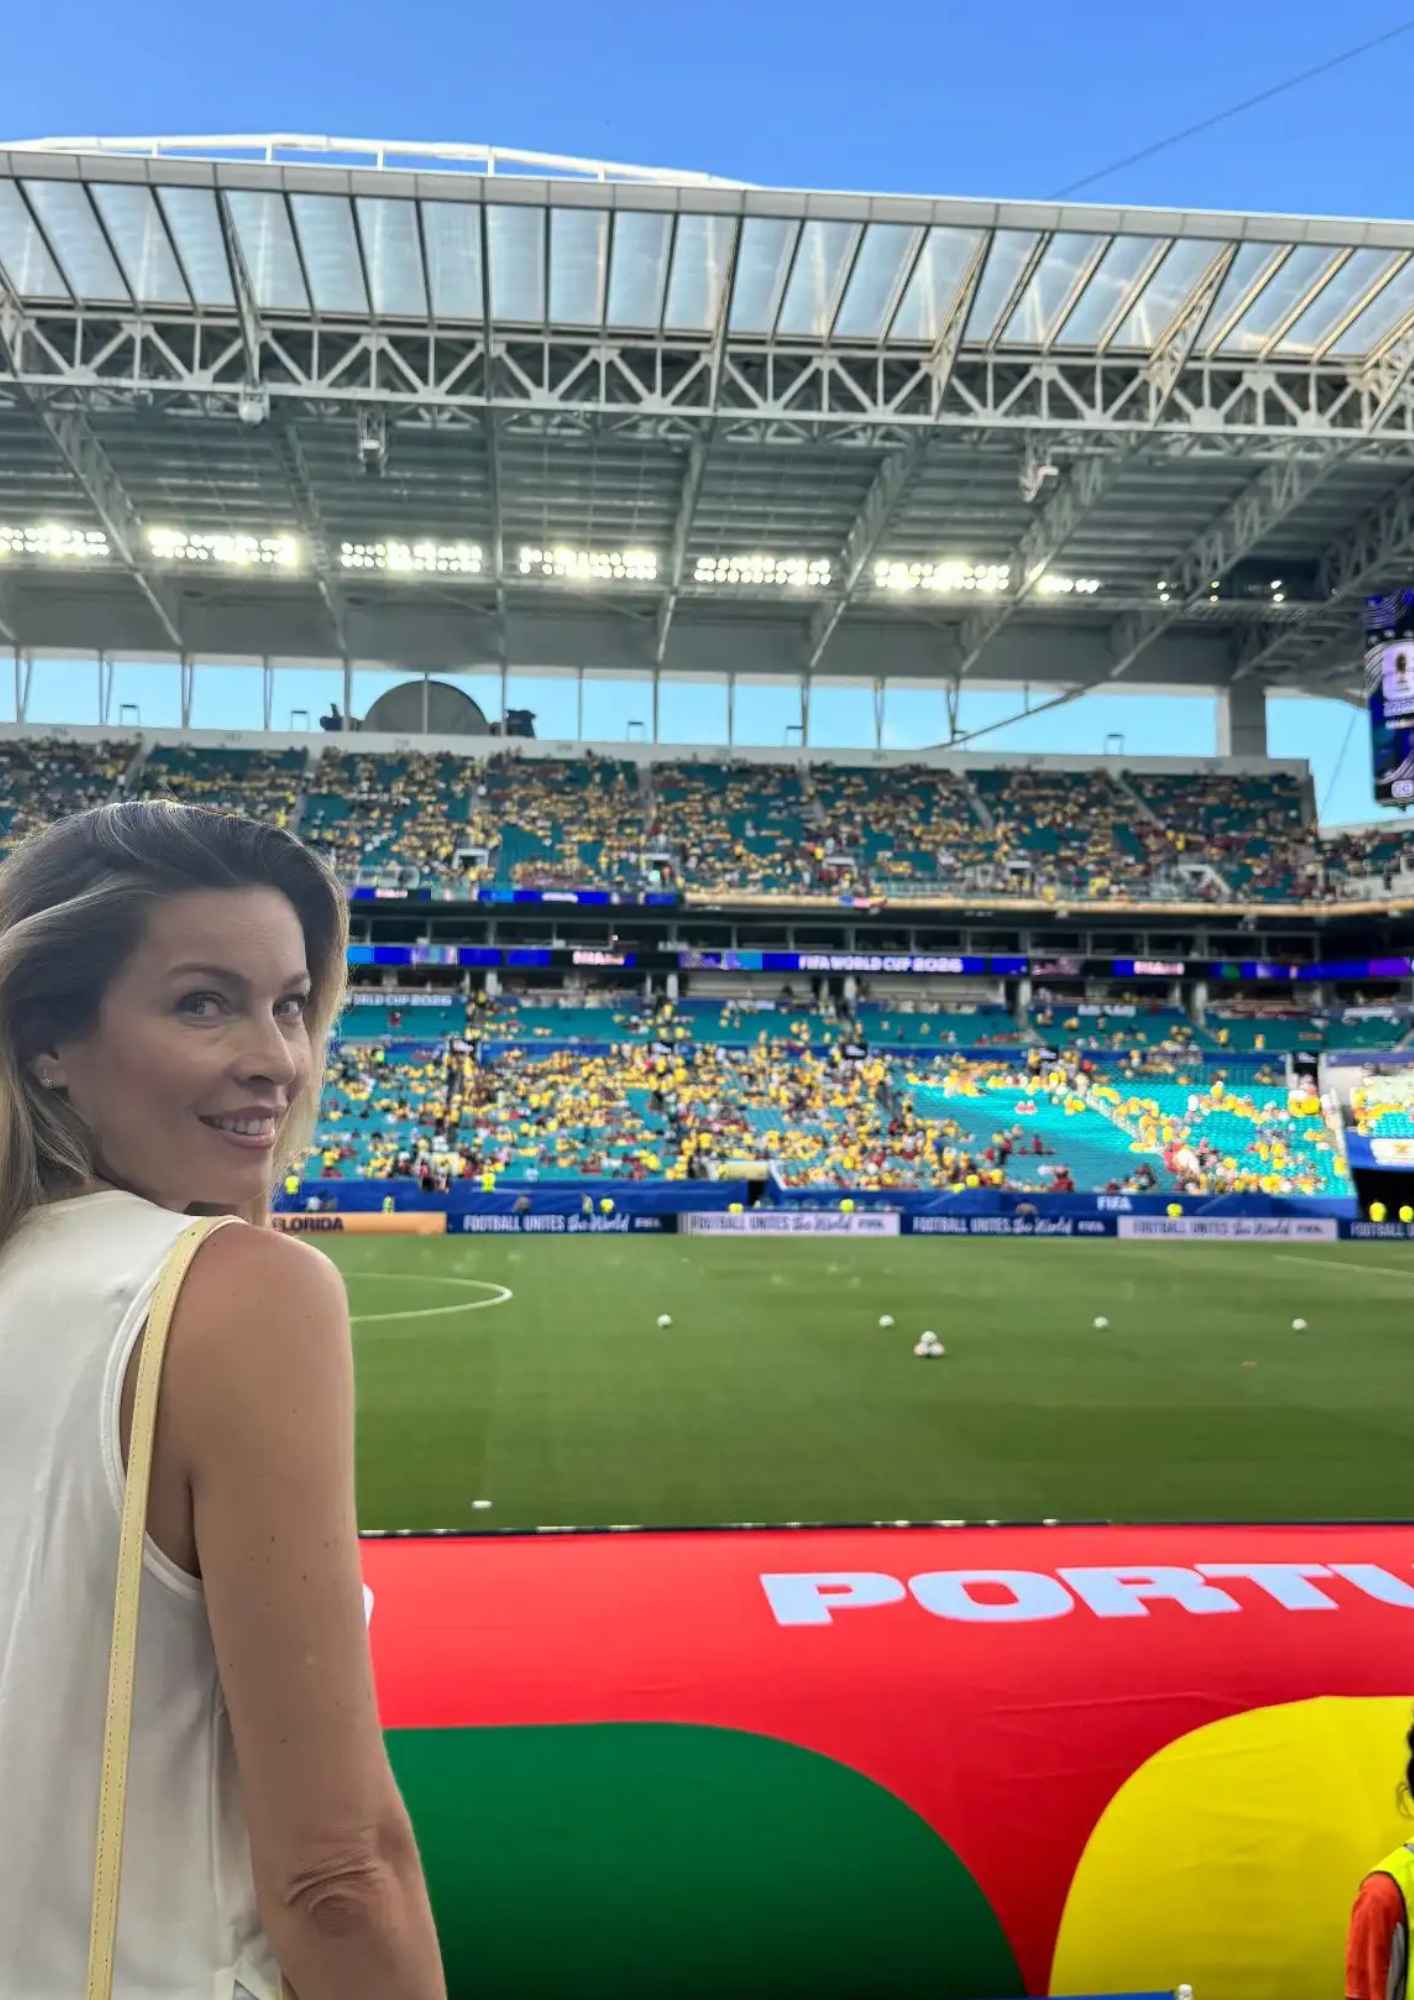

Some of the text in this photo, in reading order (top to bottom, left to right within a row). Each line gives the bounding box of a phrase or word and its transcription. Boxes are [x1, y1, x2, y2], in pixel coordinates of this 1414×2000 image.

[831, 955, 882, 972] WORLD
[883, 956, 912, 972] CUP
[912, 957, 964, 973] 2026
[1096, 1196, 1132, 1210] FIFA
[463, 1214, 521, 1231] FOOTBALL
[523, 1214, 565, 1231] UNITES
[690, 1215, 745, 1230] FOOTBALL
[749, 1215, 790, 1230] UNITES
[912, 1216, 968, 1232] FOOTBALL
[970, 1217, 1011, 1233] UNITES
[1133, 1221, 1185, 1234] FOOTBALL
[1191, 1222, 1228, 1234] UNITES
